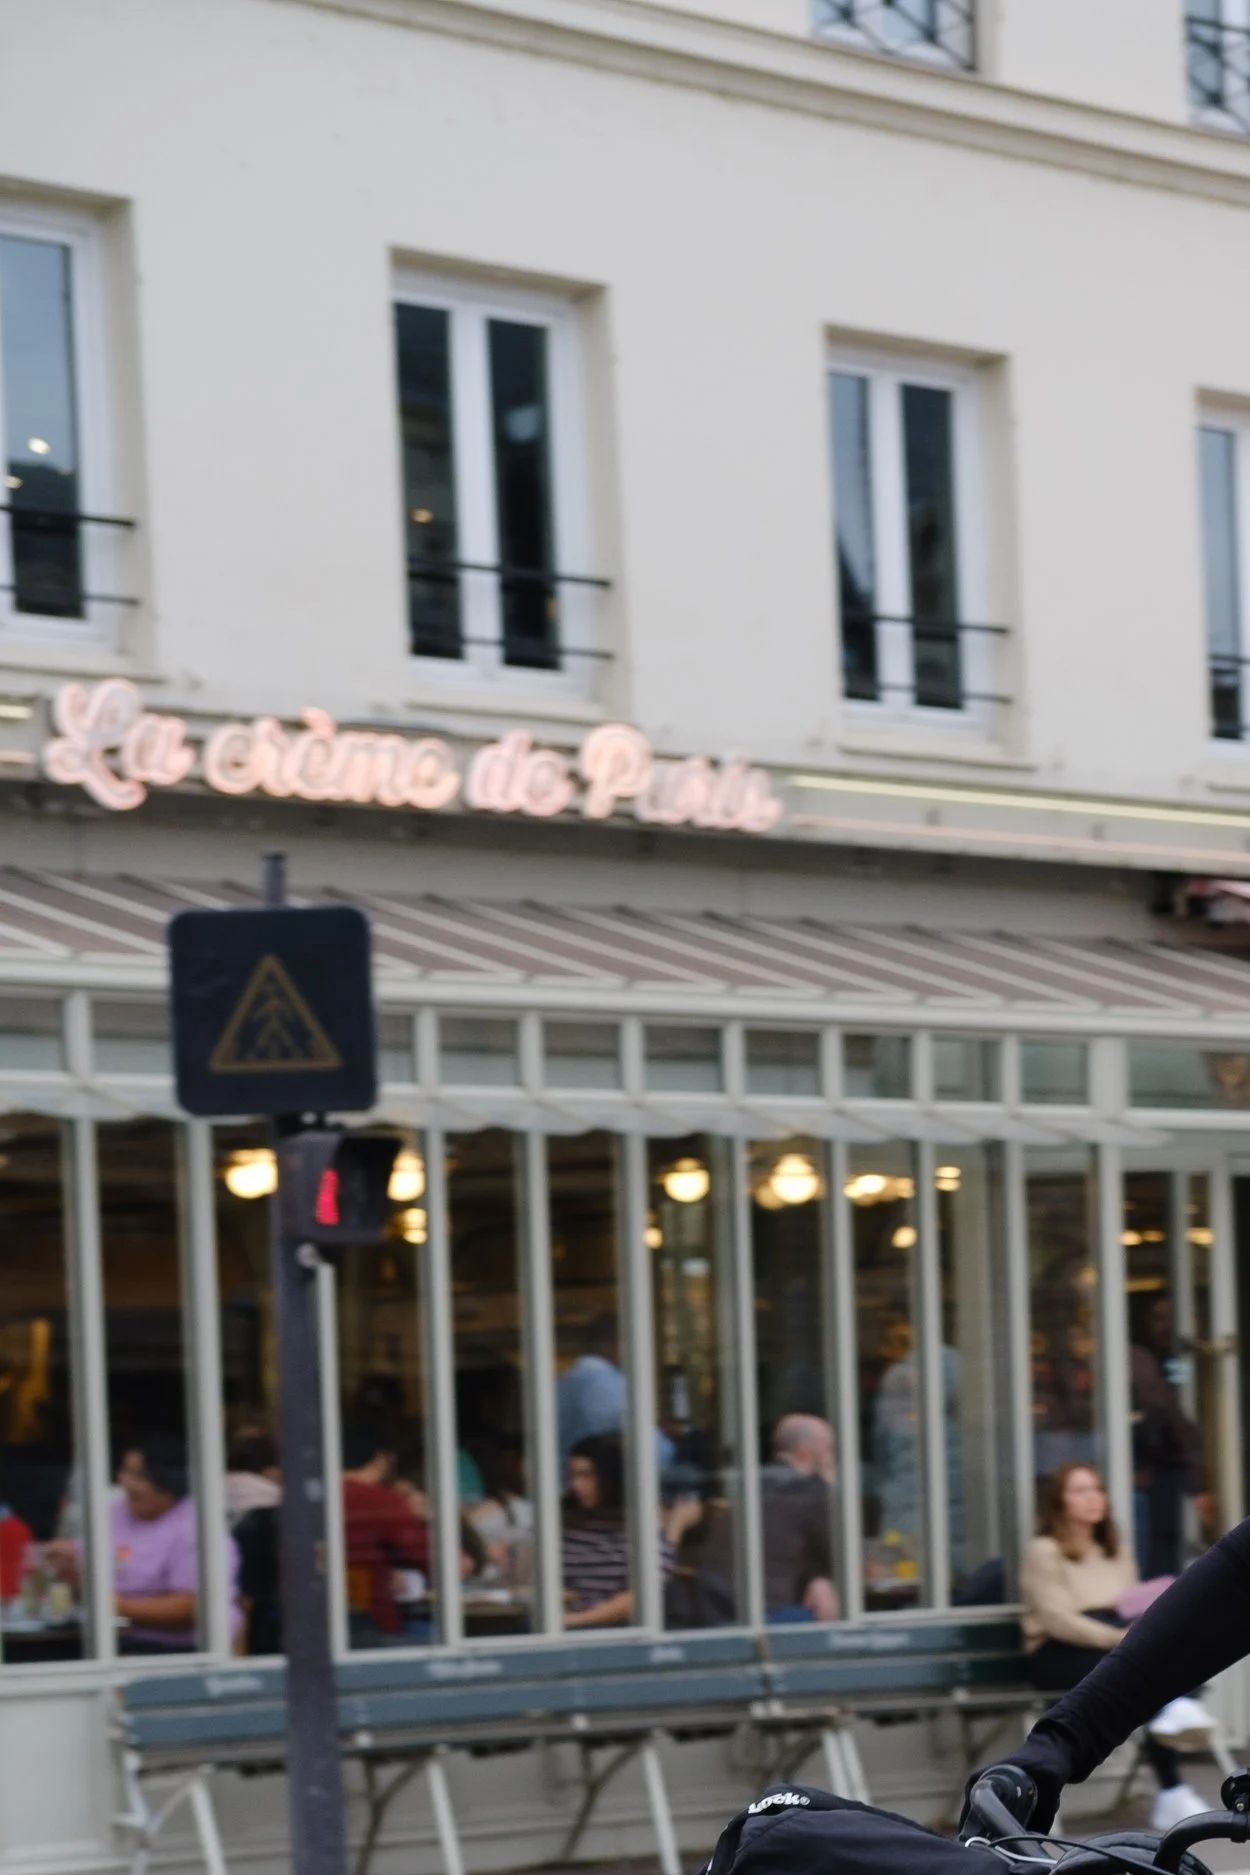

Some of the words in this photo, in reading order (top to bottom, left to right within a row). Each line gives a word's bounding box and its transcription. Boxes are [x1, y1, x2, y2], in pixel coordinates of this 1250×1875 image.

[43, 679, 196, 811] La
[205, 707, 461, 809] crème
[466, 729, 576, 816] de
[580, 723, 784, 832] Paris
